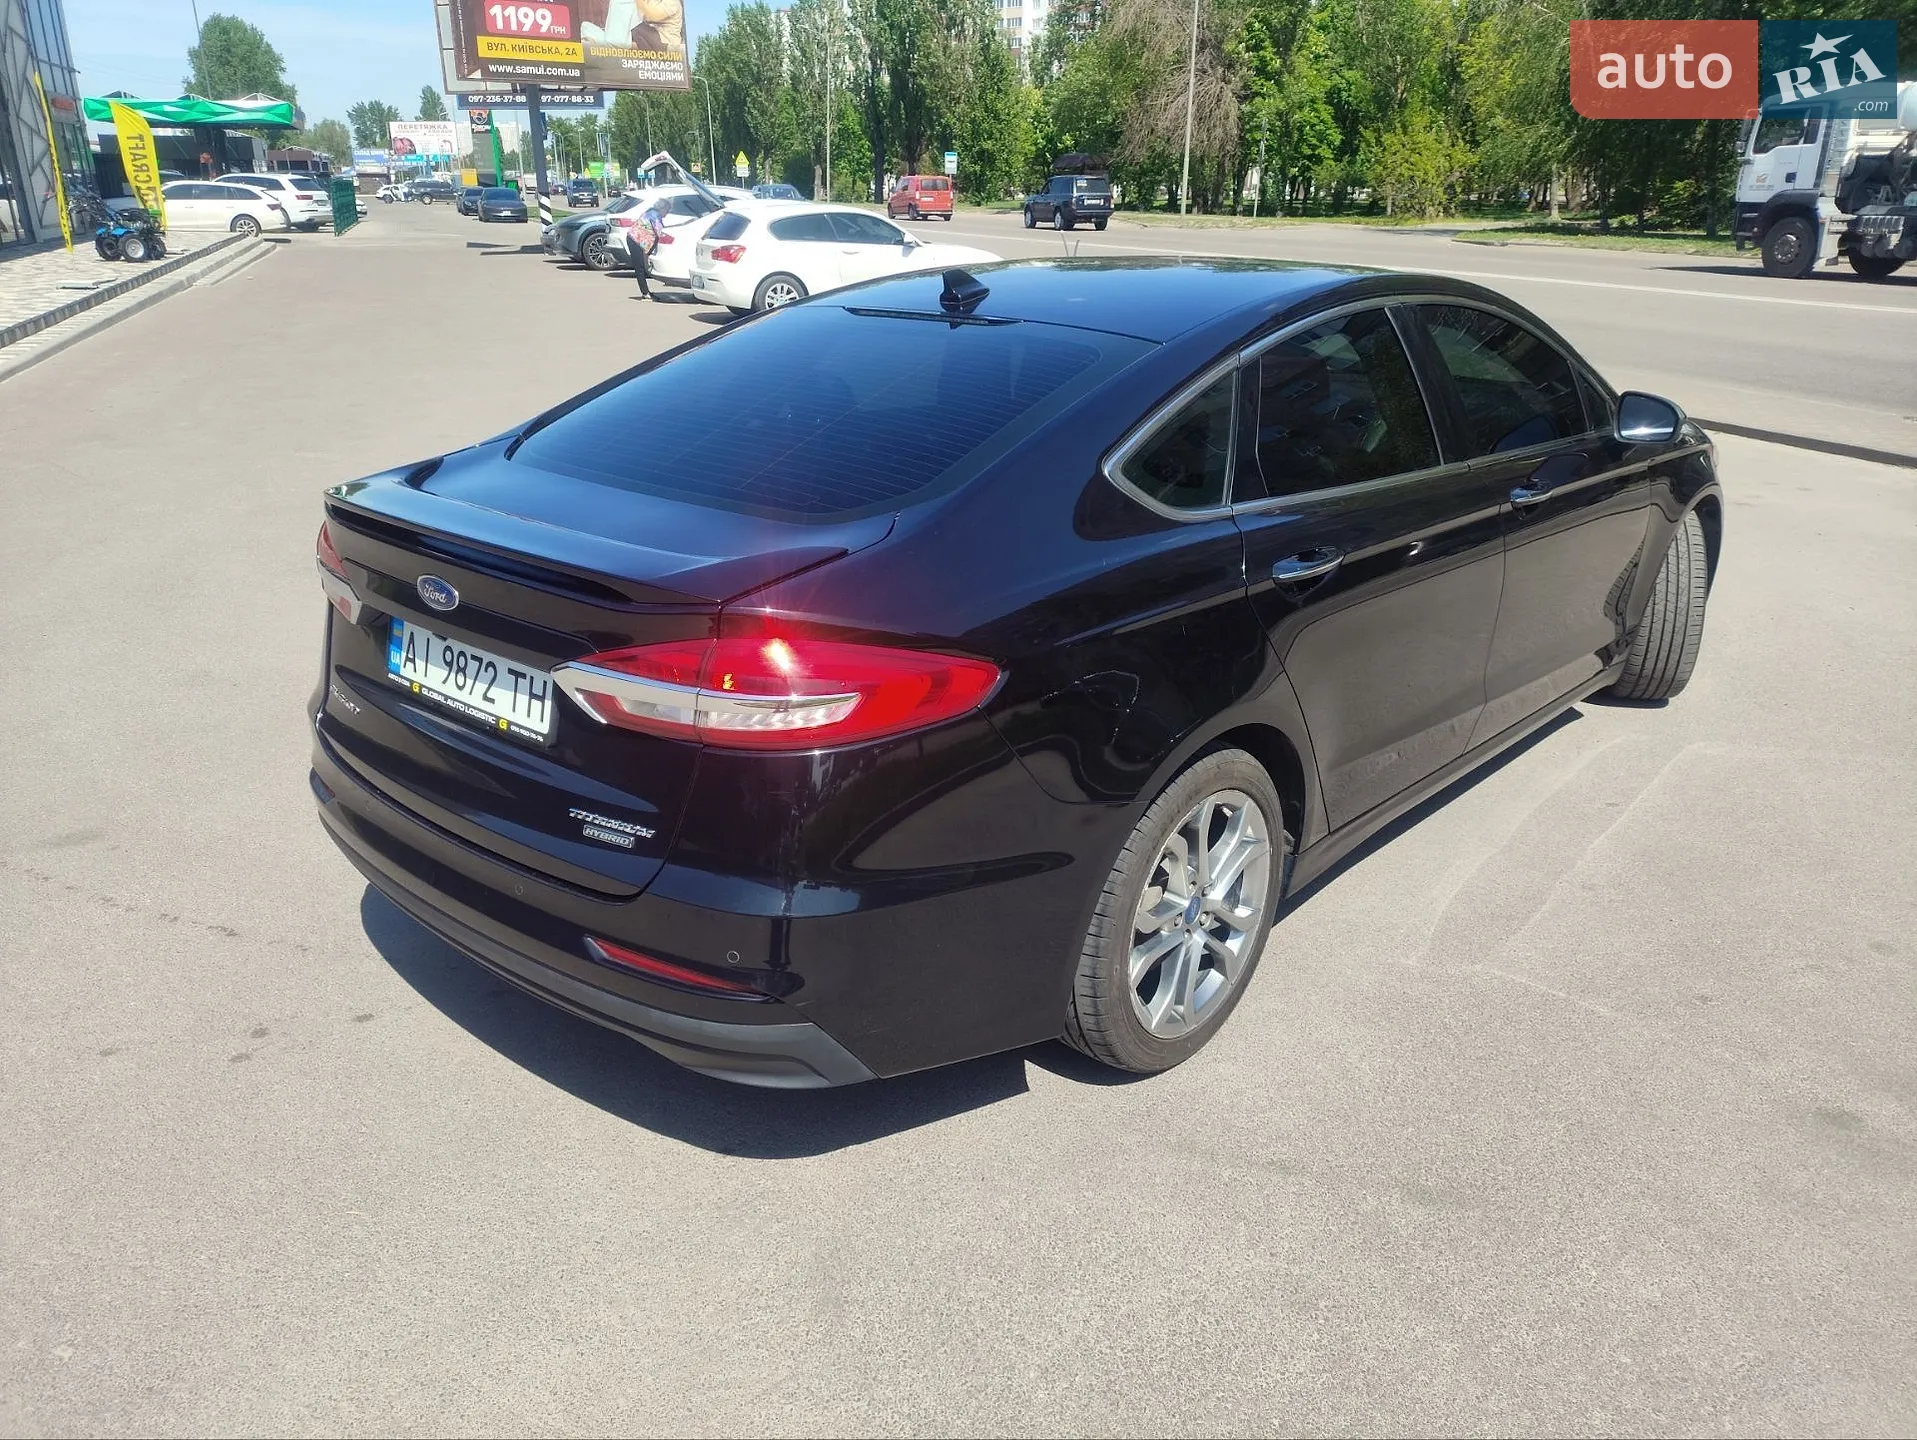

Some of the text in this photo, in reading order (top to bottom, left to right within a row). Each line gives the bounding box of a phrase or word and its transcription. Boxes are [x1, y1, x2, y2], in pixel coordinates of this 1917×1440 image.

[489, 4, 566, 35] 1199 ГРН
[487, 42, 578, 56] ВУЛ. КИЇВСЬКА, 2А
[590, 47, 683, 61] ВІДНОВЛЮЄМО СИЛИ
[488, 64, 580, 77] www.samui.com.ua
[622, 59, 683, 71] ЗАРЯДЖАЄМО
[639, 70, 684, 81] ЕМОЦІЯМИ
[424, 584, 447, 603] Ford
[403, 631, 548, 723] AI 9872 TH
[421, 687, 446, 704] GLOBAL
[446, 699, 465, 712] AUTO
[465, 706, 496, 725] LOGISTIC
[585, 828, 630, 845] HYBRID
